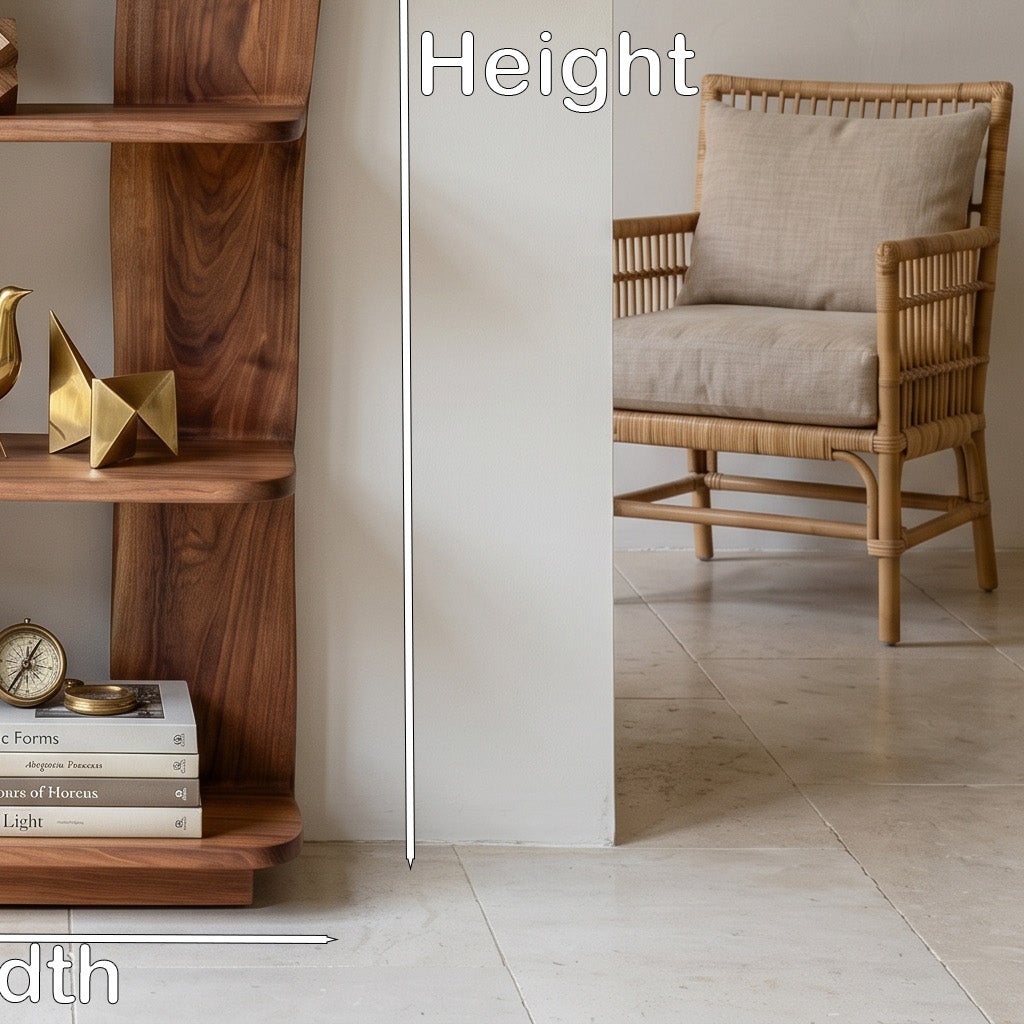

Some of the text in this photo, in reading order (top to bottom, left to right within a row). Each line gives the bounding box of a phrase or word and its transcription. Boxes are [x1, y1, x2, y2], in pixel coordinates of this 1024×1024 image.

[13, 731, 60, 746] Forms
[30, 785, 46, 799] of
[3, 813, 44, 832] Light
